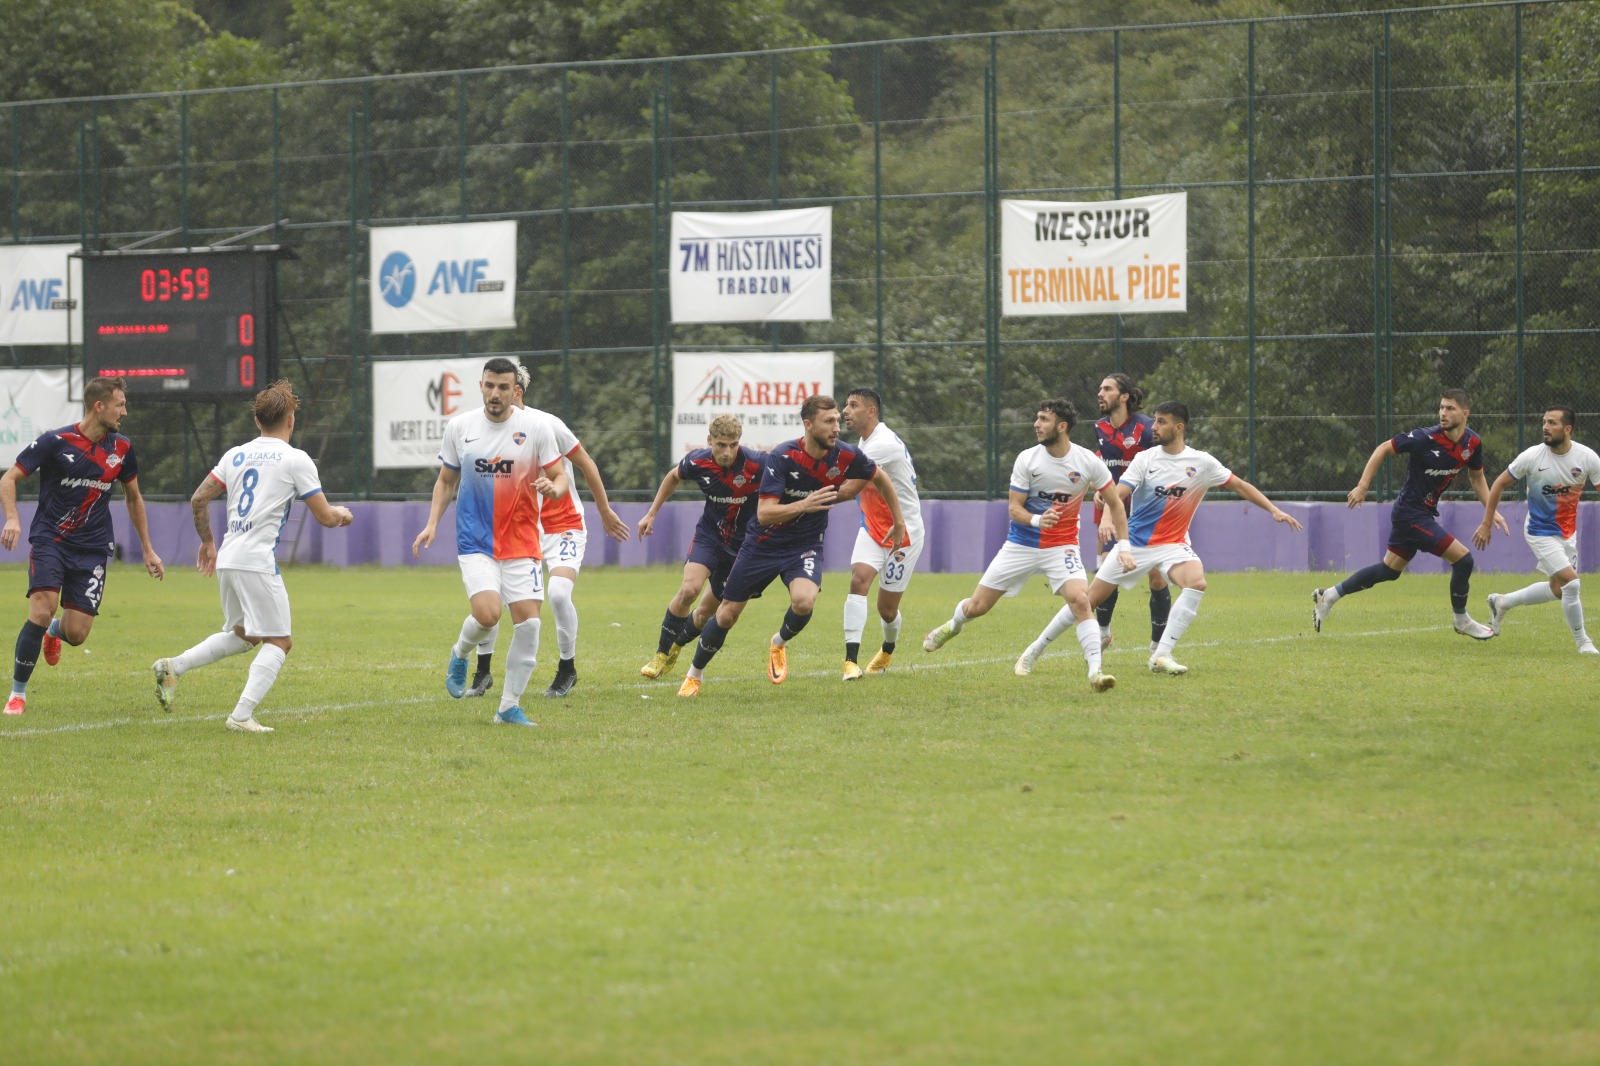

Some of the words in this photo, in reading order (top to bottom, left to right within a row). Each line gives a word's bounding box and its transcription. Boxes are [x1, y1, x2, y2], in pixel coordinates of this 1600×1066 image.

[1035, 208, 1150, 247] MEŞHUR
[680, 243, 710, 272] 7M
[141, 268, 209, 302] 03:59
[717, 276, 792, 295] TRABZON
[1008, 256, 1120, 303] TERMİNAL
[1127, 254, 1181, 300] PİDE
[240, 314, 254, 346] 0
[240, 356, 254, 387] 0
[390, 420, 422, 441] MERT
[238, 468, 259, 518] 8
[560, 541, 577, 557] 23
[804, 558, 815, 569] 5
[886, 562, 905, 580] 33
